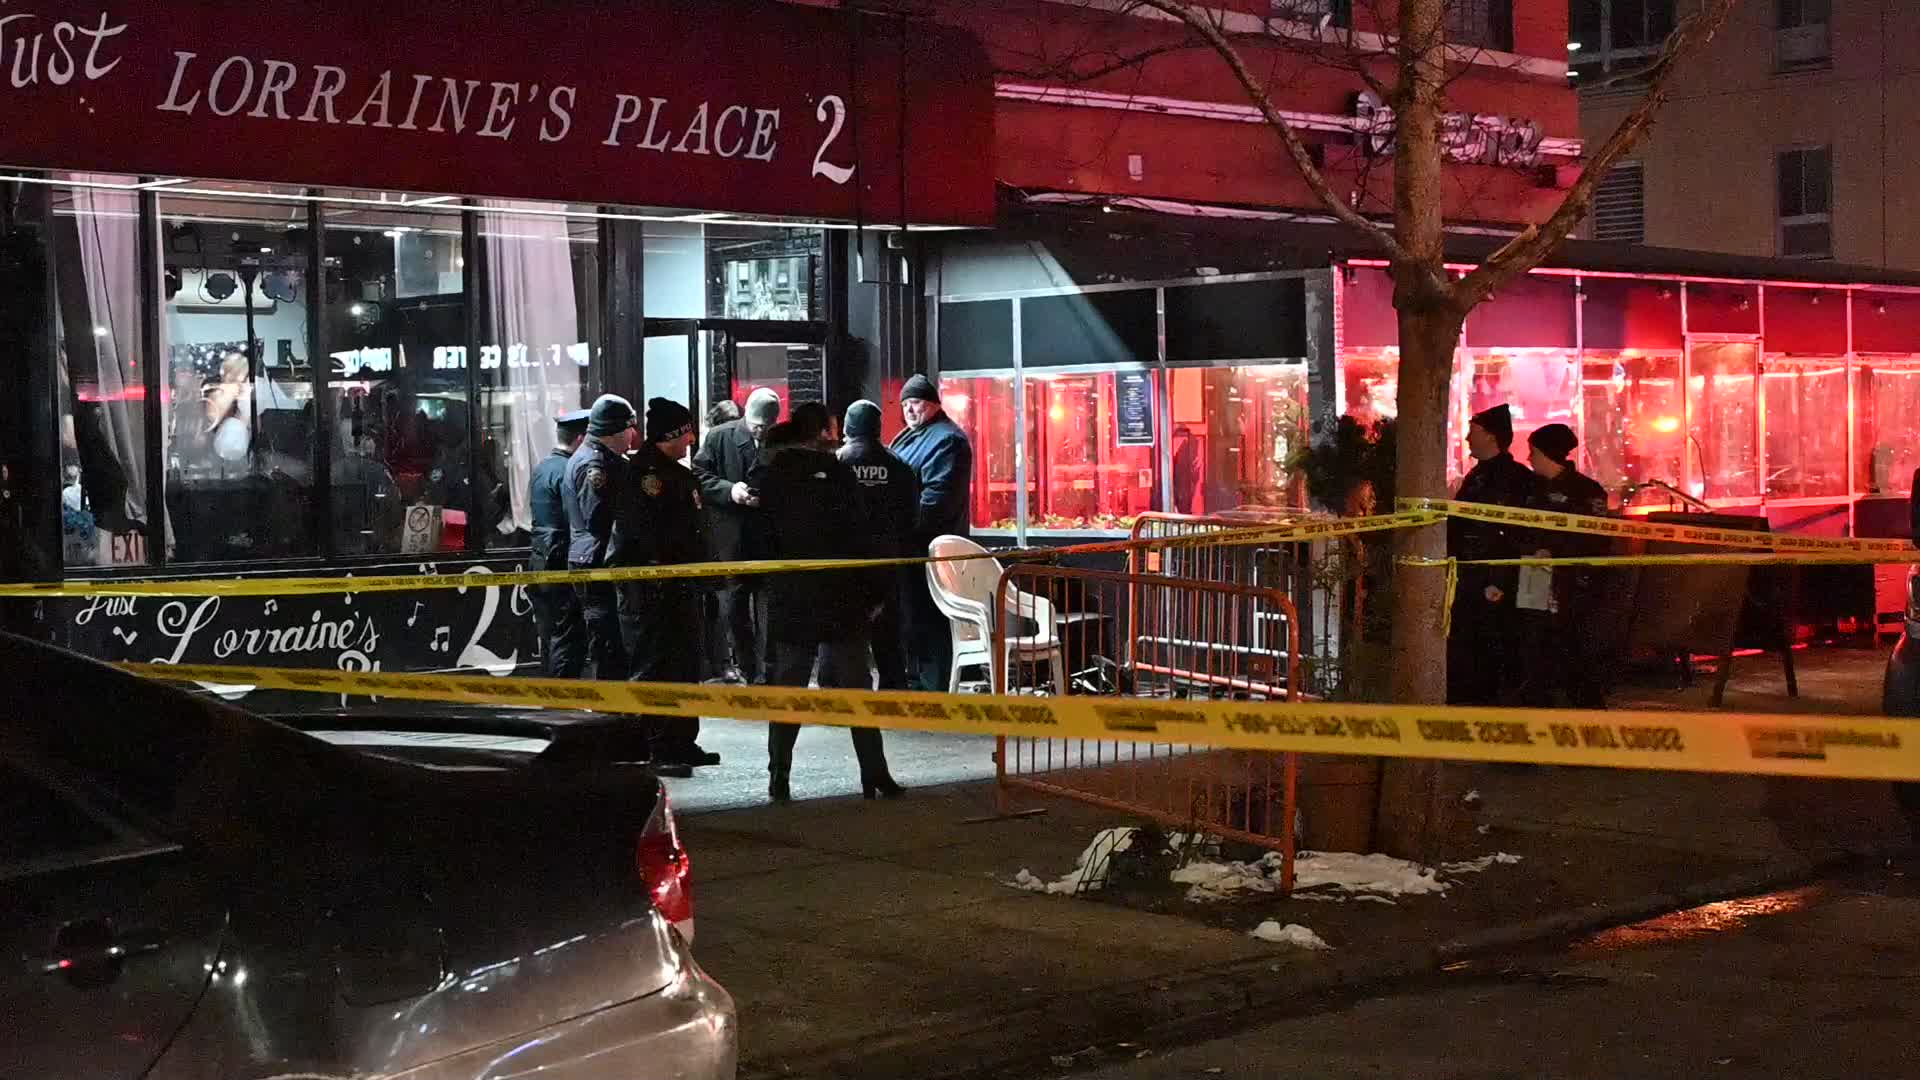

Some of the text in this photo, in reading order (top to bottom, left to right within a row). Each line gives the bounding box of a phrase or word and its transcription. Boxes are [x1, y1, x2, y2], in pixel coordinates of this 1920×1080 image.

[156, 51, 577, 142] LORRAINE'S
[602, 94, 780, 162] PLACE
[811, 94, 856, 185] 2
[150, 596, 381, 699] Lorraine's
[457, 565, 518, 677] 2
